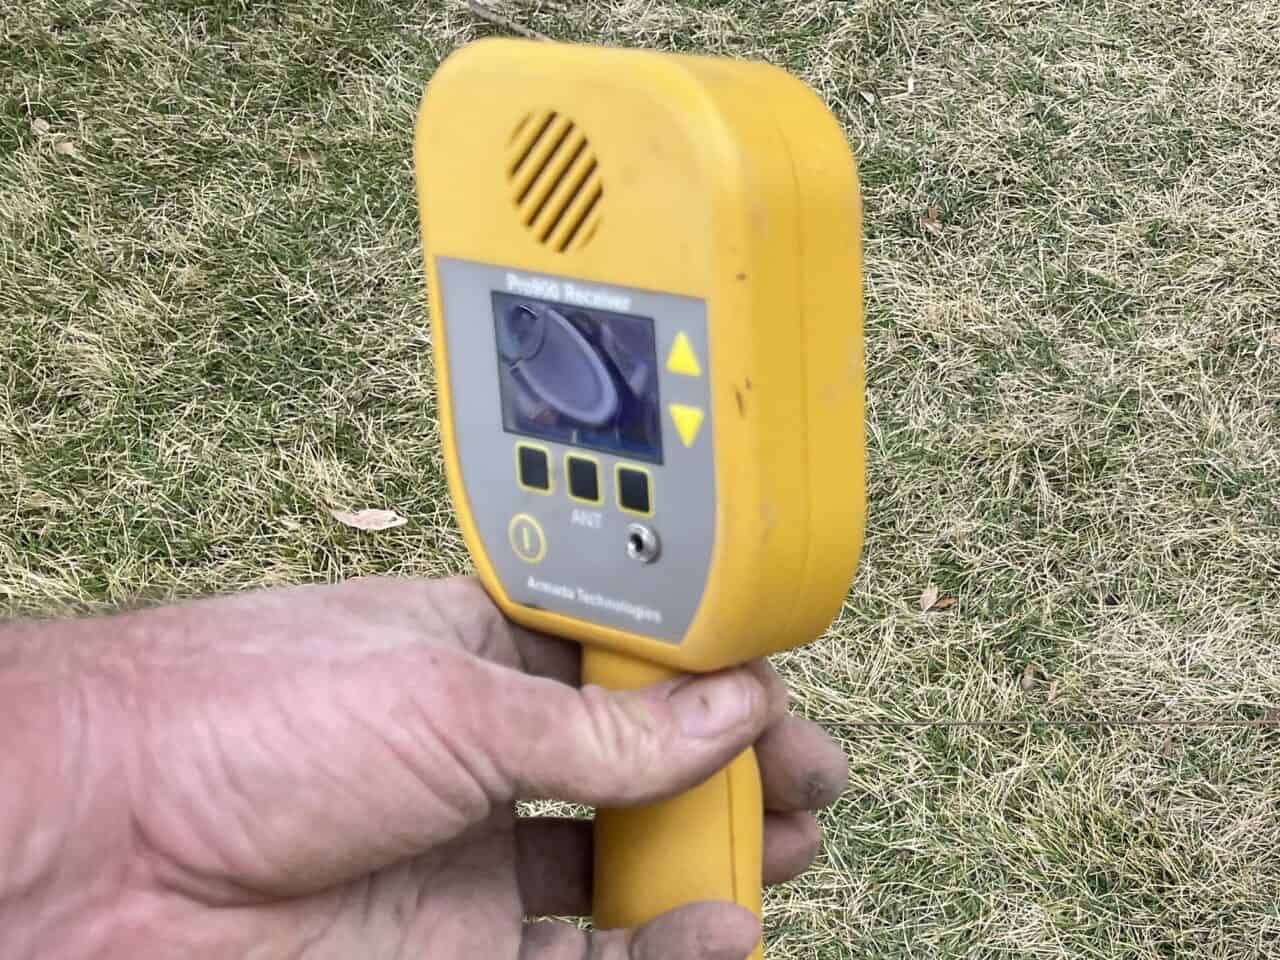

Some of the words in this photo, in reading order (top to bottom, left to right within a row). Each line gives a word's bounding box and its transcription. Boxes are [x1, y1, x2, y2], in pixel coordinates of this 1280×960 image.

[563, 282, 632, 312] Receiver
[571, 508, 602, 528] ANT
[527, 575, 575, 600] Armada
[576, 587, 662, 623] Technologies
